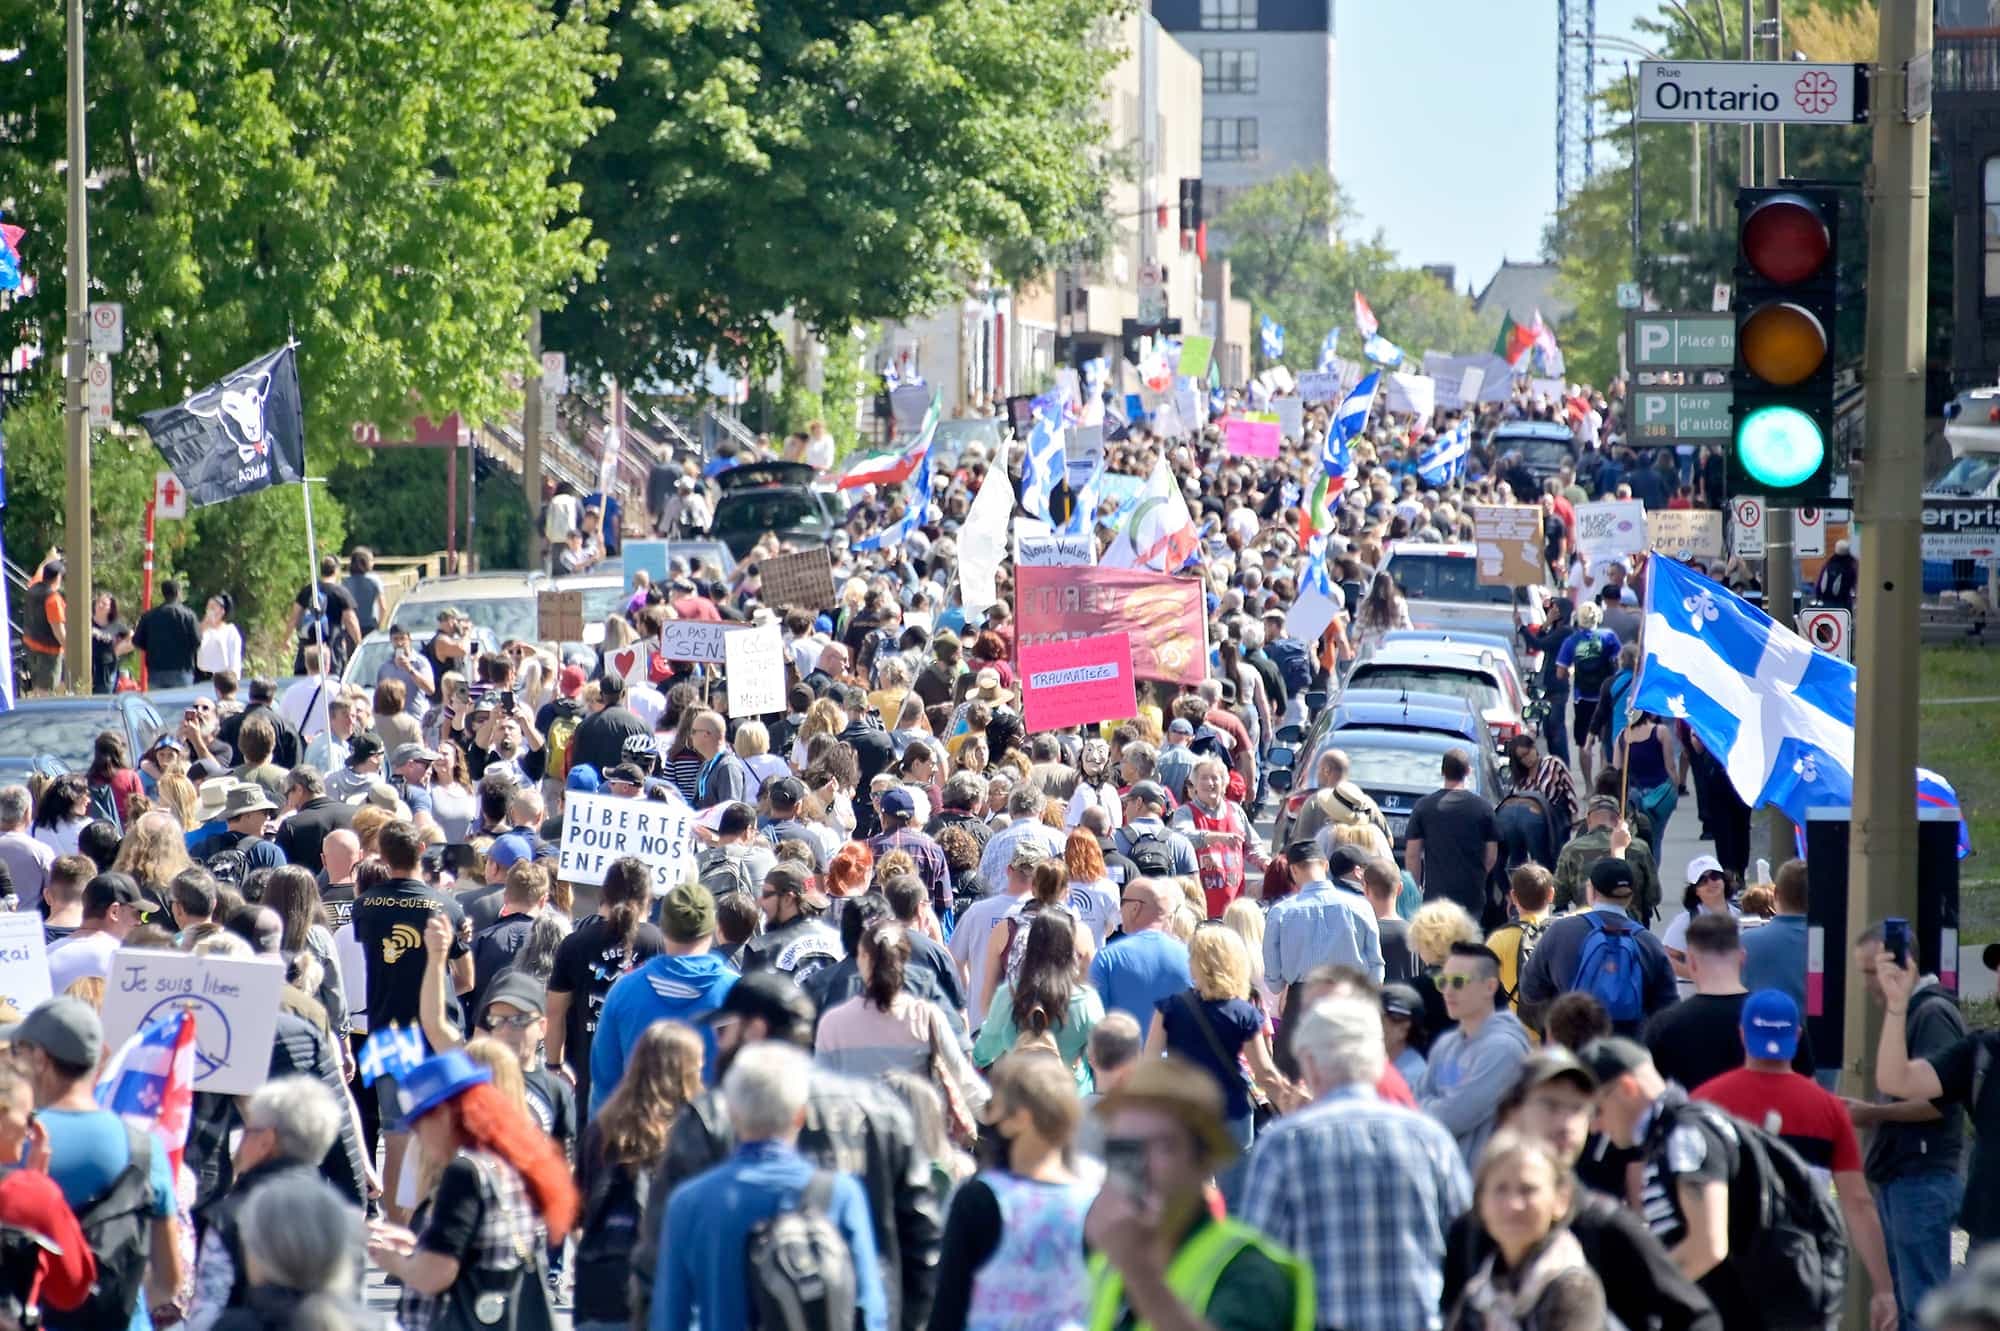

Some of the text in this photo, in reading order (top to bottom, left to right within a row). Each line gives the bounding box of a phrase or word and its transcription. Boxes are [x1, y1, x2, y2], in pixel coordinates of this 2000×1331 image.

[1656, 67, 1681, 78] Rue
[1655, 82, 1780, 112] Ontario
[1640, 324, 1670, 361] P
[1679, 335, 1715, 348] Place
[1645, 396, 1667, 421] P
[1679, 397, 1711, 409] Gare
[687, 626, 708, 638] PAS
[569, 825, 682, 859] POUR NOS
[120, 965, 148, 993] Je
[154, 977, 193, 993] suis
